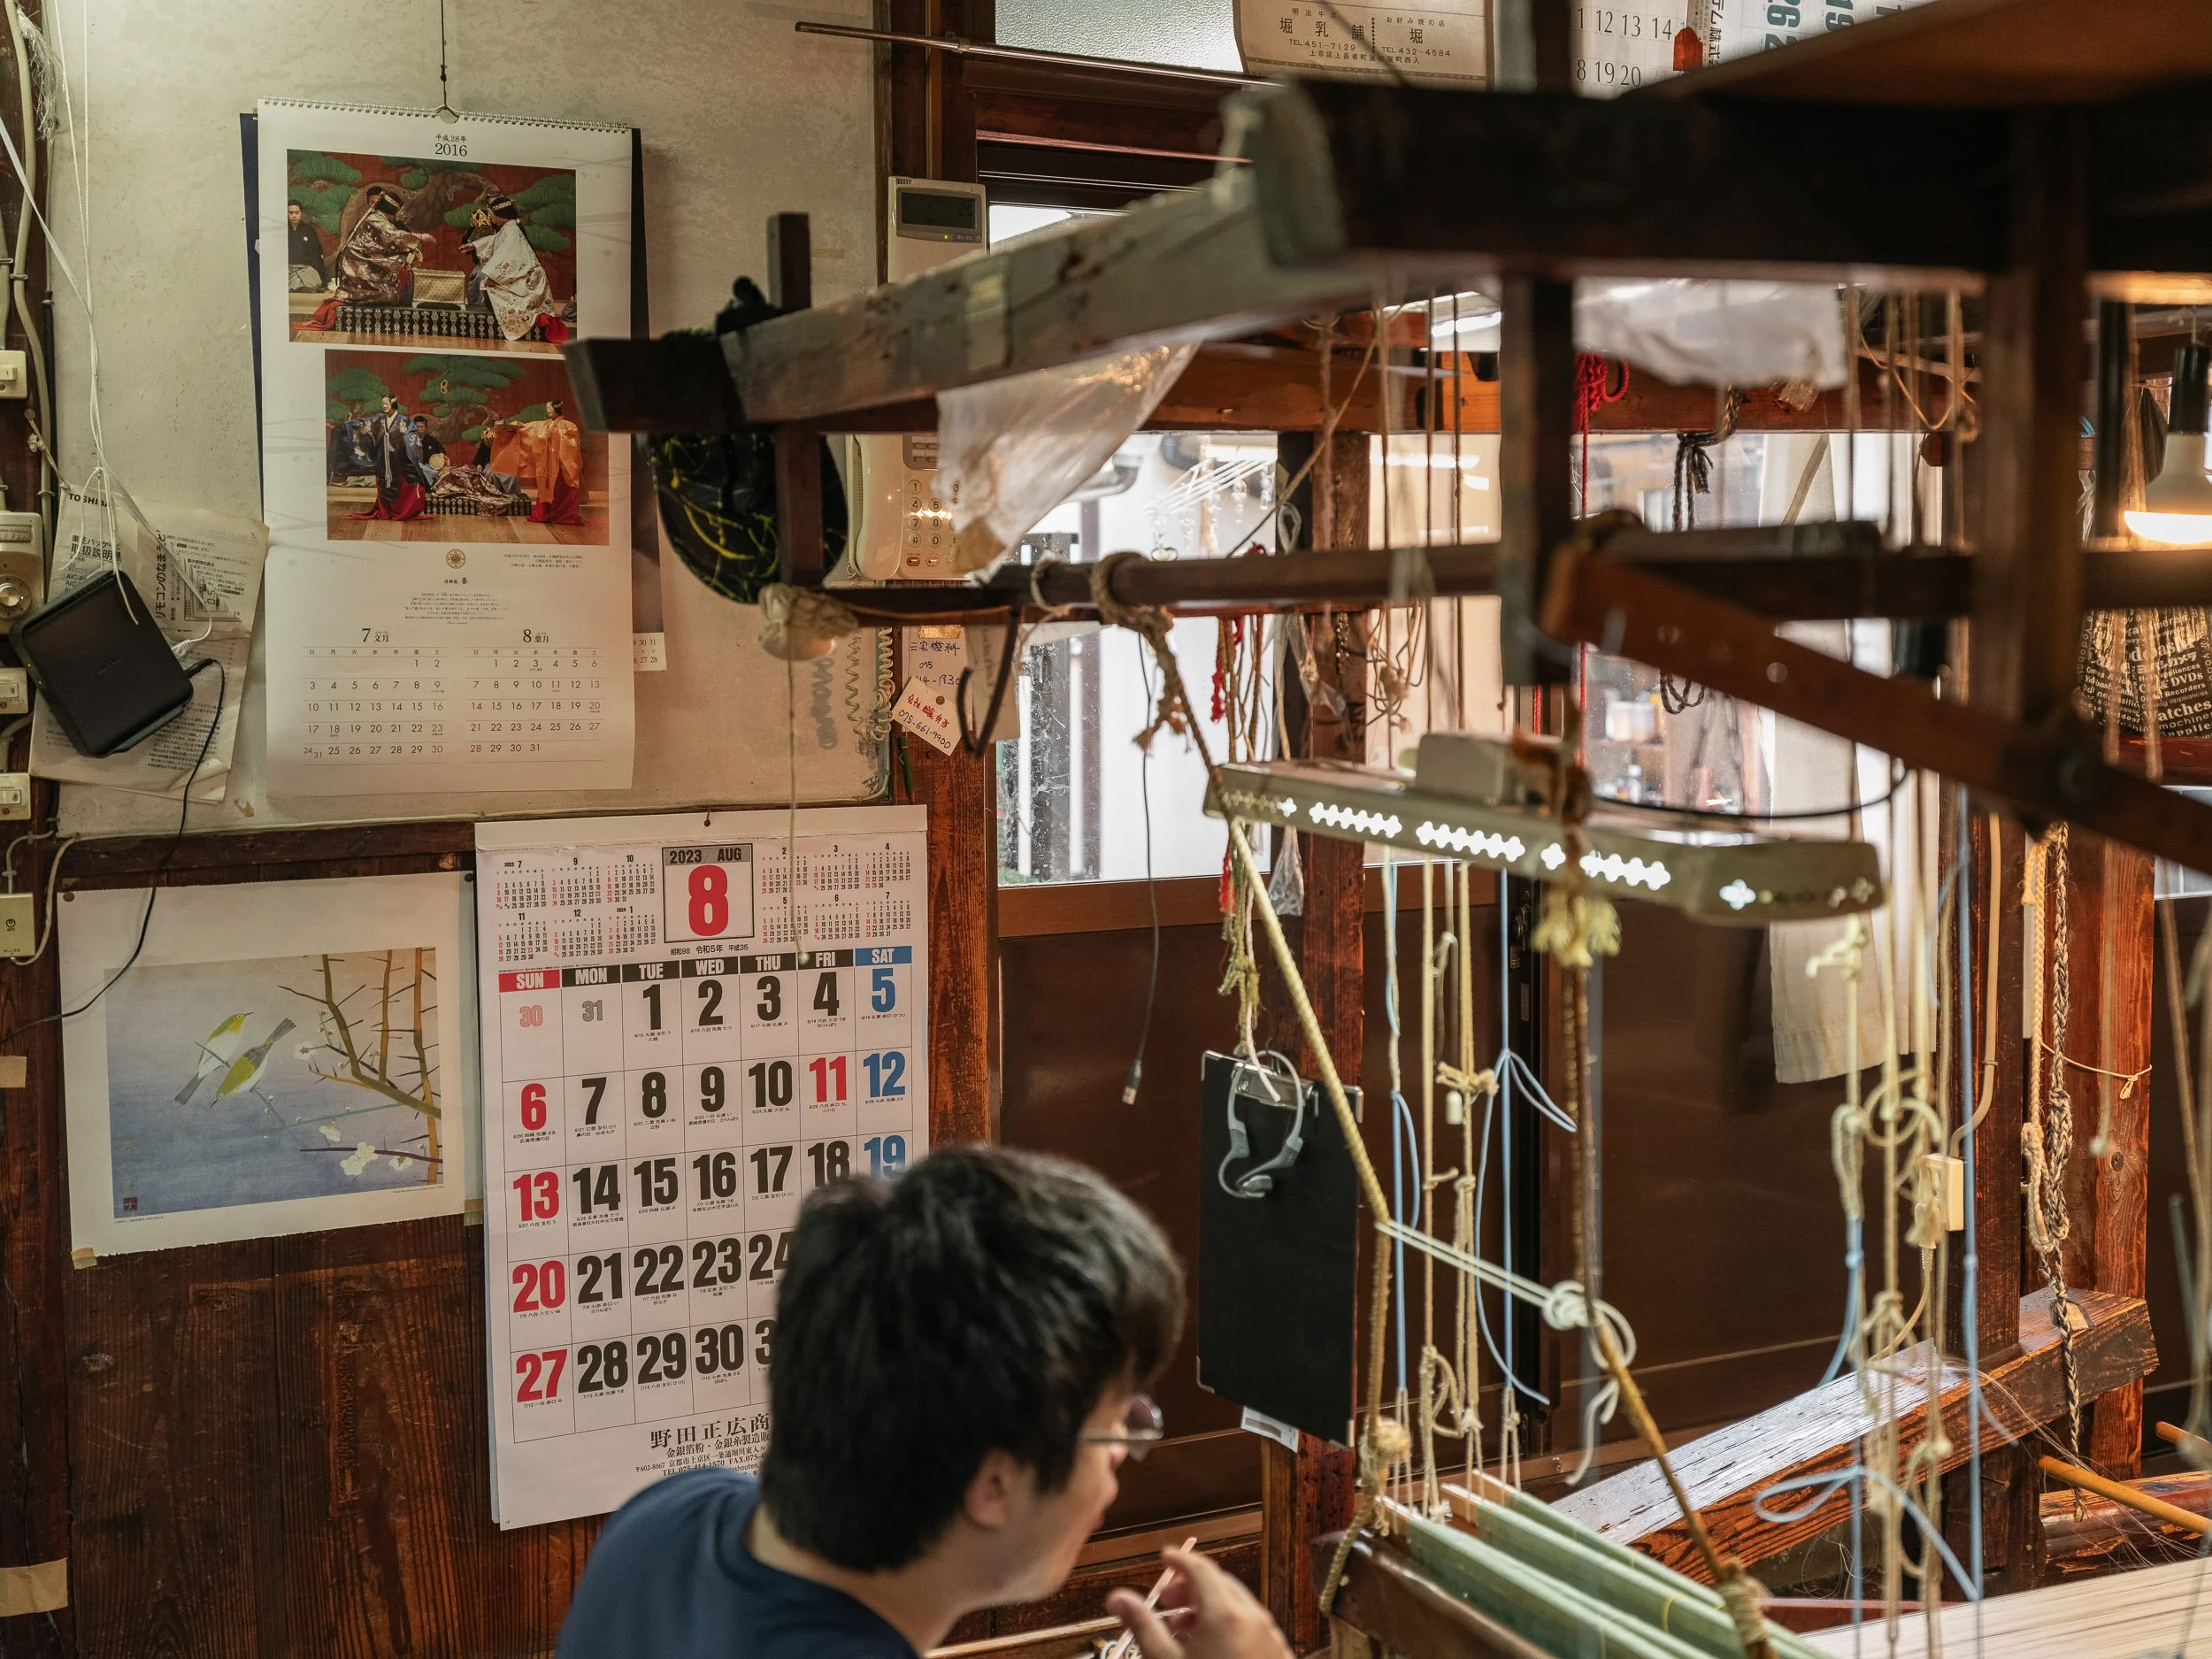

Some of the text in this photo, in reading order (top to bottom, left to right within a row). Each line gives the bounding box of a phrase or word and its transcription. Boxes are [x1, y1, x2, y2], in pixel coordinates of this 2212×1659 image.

[1292, 8, 1337, 19] 明治牛乳
[1386, 17, 1445, 27] お好み焼の店
[1596, 10, 1613, 33] 12
[1622, 14, 1641, 36] 13
[1652, 18, 1672, 40] 14
[1409, 28, 1423, 44] 堀
[1305, 41, 1356, 50] 451-7129
[1401, 48, 1450, 57] 432-4584
[1594, 62, 1615, 84] 19
[1620, 65, 1641, 87] 20
[435, 134, 467, 142] 平成28年
[435, 143, 467, 157] 2016
[362, 628, 371, 641] 7
[523, 629, 531, 642] 8
[2170, 672, 2203, 687] DVDs
[2165, 683, 2206, 697] Recorders
[898, 709, 951, 749] 075-661-9900
[670, 849, 741, 864] 2023 AUG
[688, 864, 728, 937] 8
[695, 944, 723, 953] 令和5年
[516, 948, 895, 989] SUN MON TUE WED THU FRI SAT
[518, 967, 895, 1030] 30 31 1 2 3 4 5
[520, 1051, 906, 1131] 6 7 8 9 10 11 12
[512, 1135, 905, 1221] 13 14 15 16 17 18 19
[512, 1260, 565, 1313] 20
[577, 1252, 623, 1304] 21
[634, 1245, 685, 1297] 22
[692, 1239, 741, 1288] 23
[515, 1325, 744, 1402] 27 28 29 30
